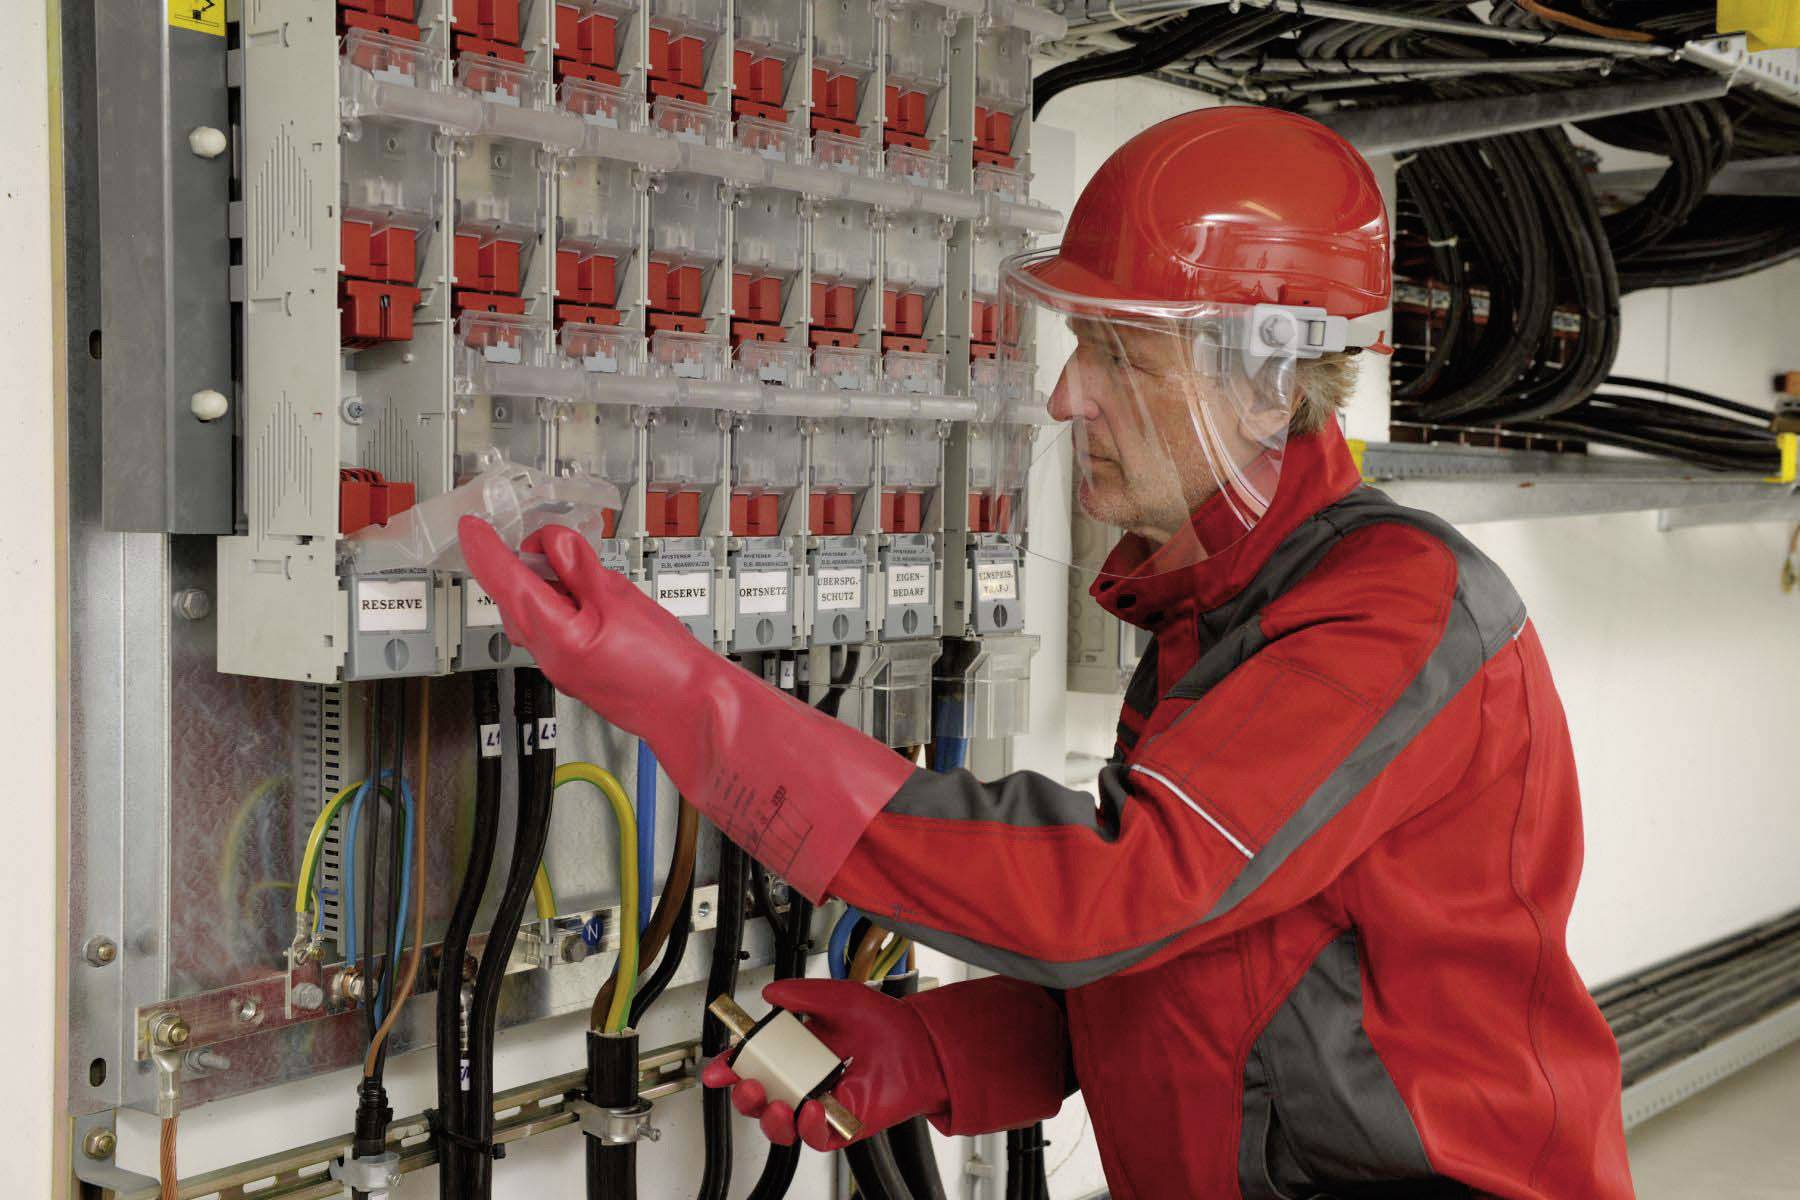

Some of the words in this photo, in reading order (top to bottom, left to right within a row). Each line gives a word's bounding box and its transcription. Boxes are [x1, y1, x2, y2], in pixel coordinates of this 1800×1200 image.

[896, 573, 925, 582] EIGEN-
[659, 588, 707, 599] RESERVE
[739, 586, 788, 598] ORTSNETZ
[821, 592, 855, 602] SCHUTZ
[892, 588, 926, 598] BEDARF
[361, 599, 423, 611] RESERVE
[541, 723, 557, 740] L3
[587, 922, 599, 941] N
